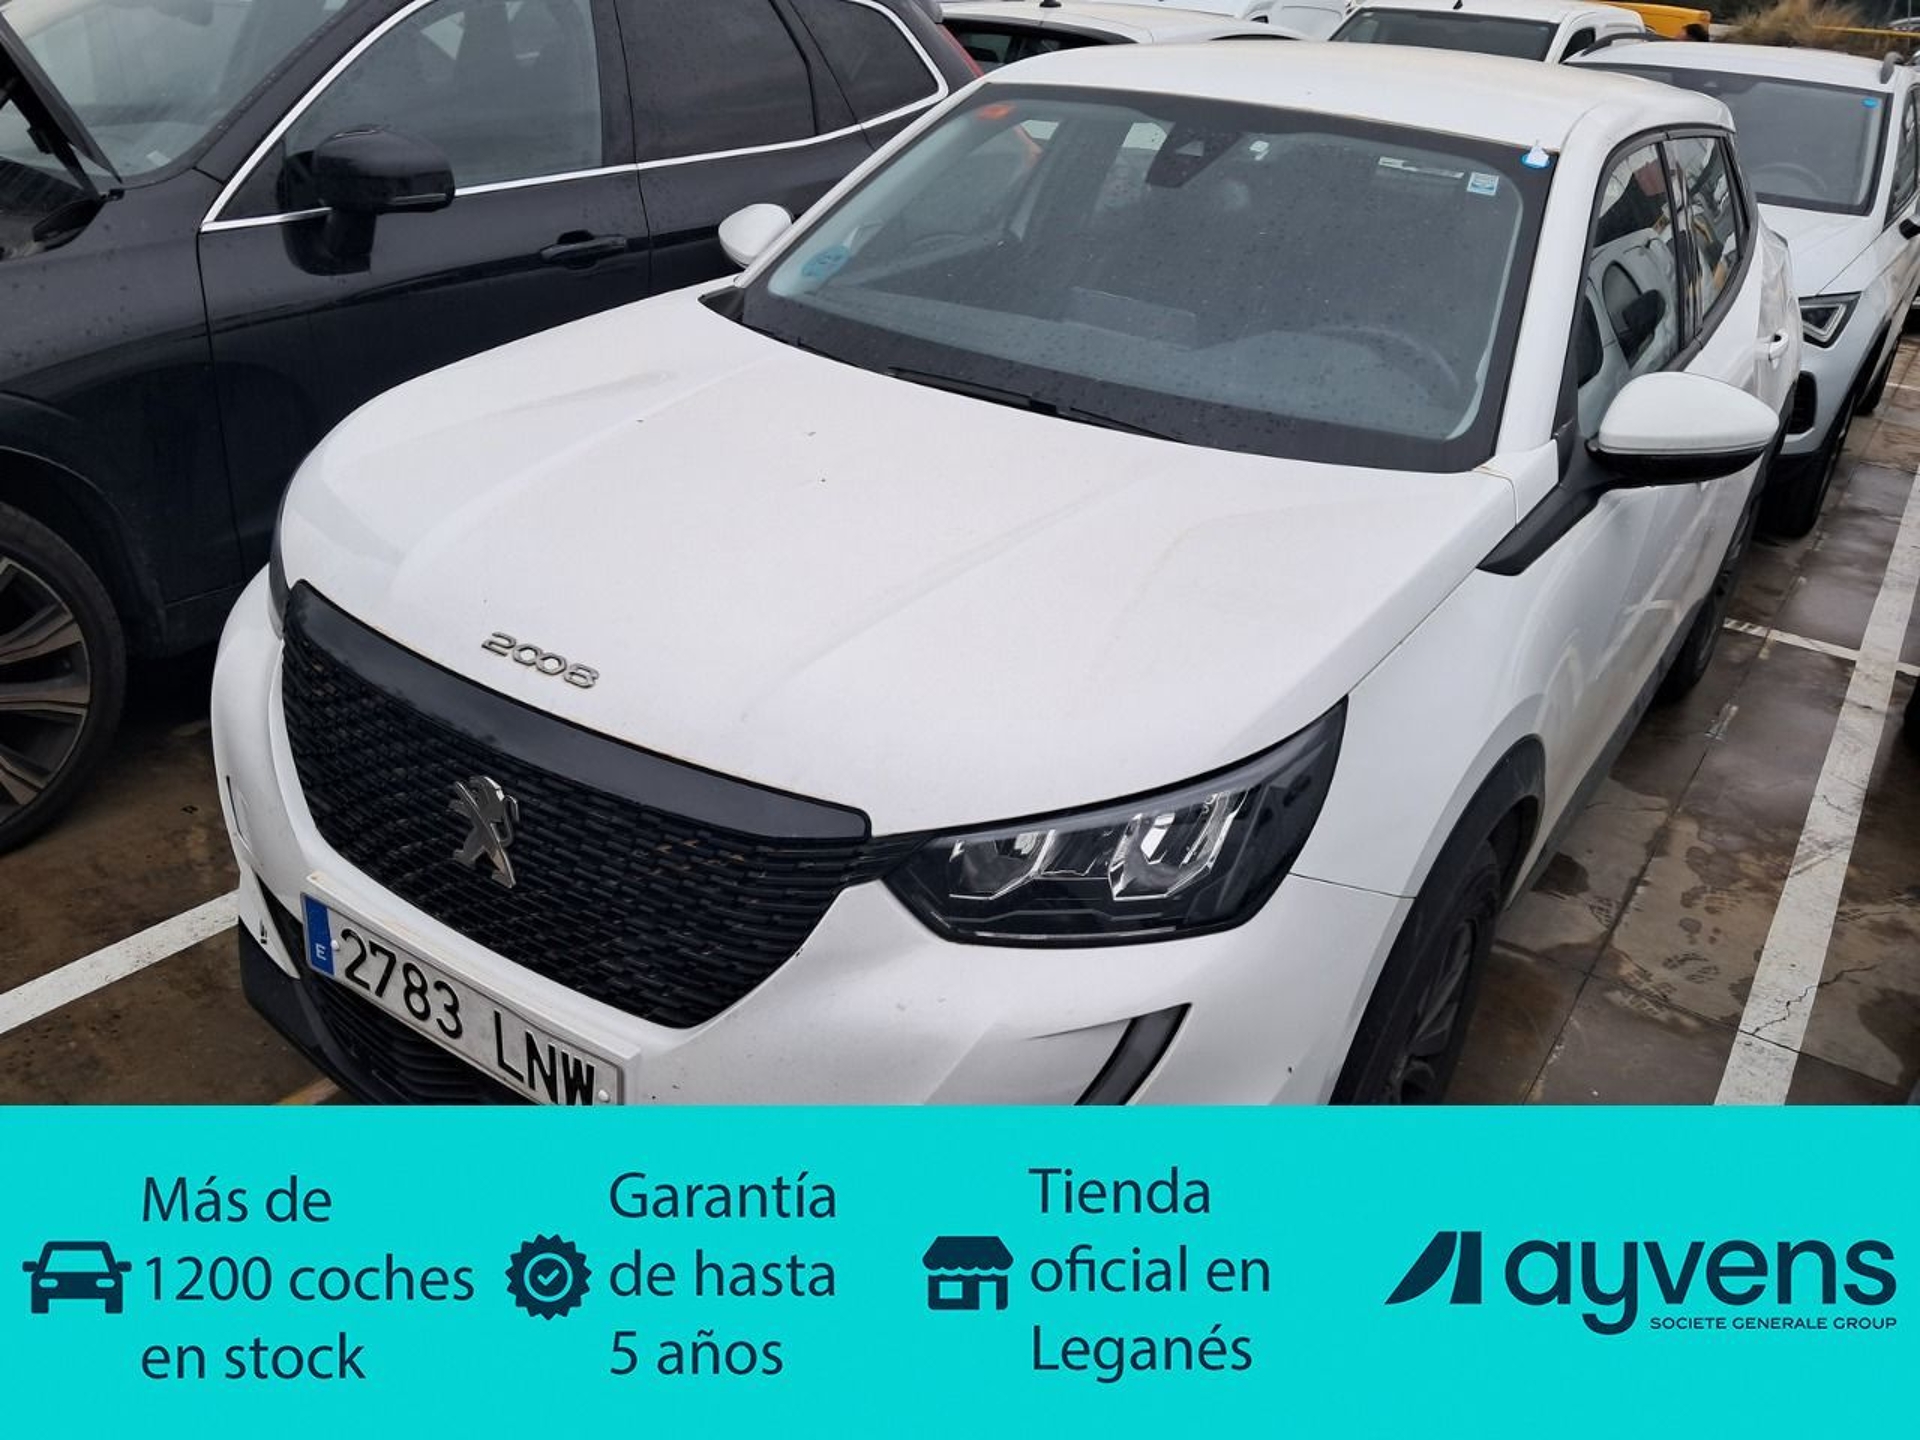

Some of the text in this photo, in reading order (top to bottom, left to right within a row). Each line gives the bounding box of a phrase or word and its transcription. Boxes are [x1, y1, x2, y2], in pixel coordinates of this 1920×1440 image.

[481, 631, 600, 689] 2008
[315, 942, 327, 962] E
[340, 928, 595, 1106] 2783 LNW
